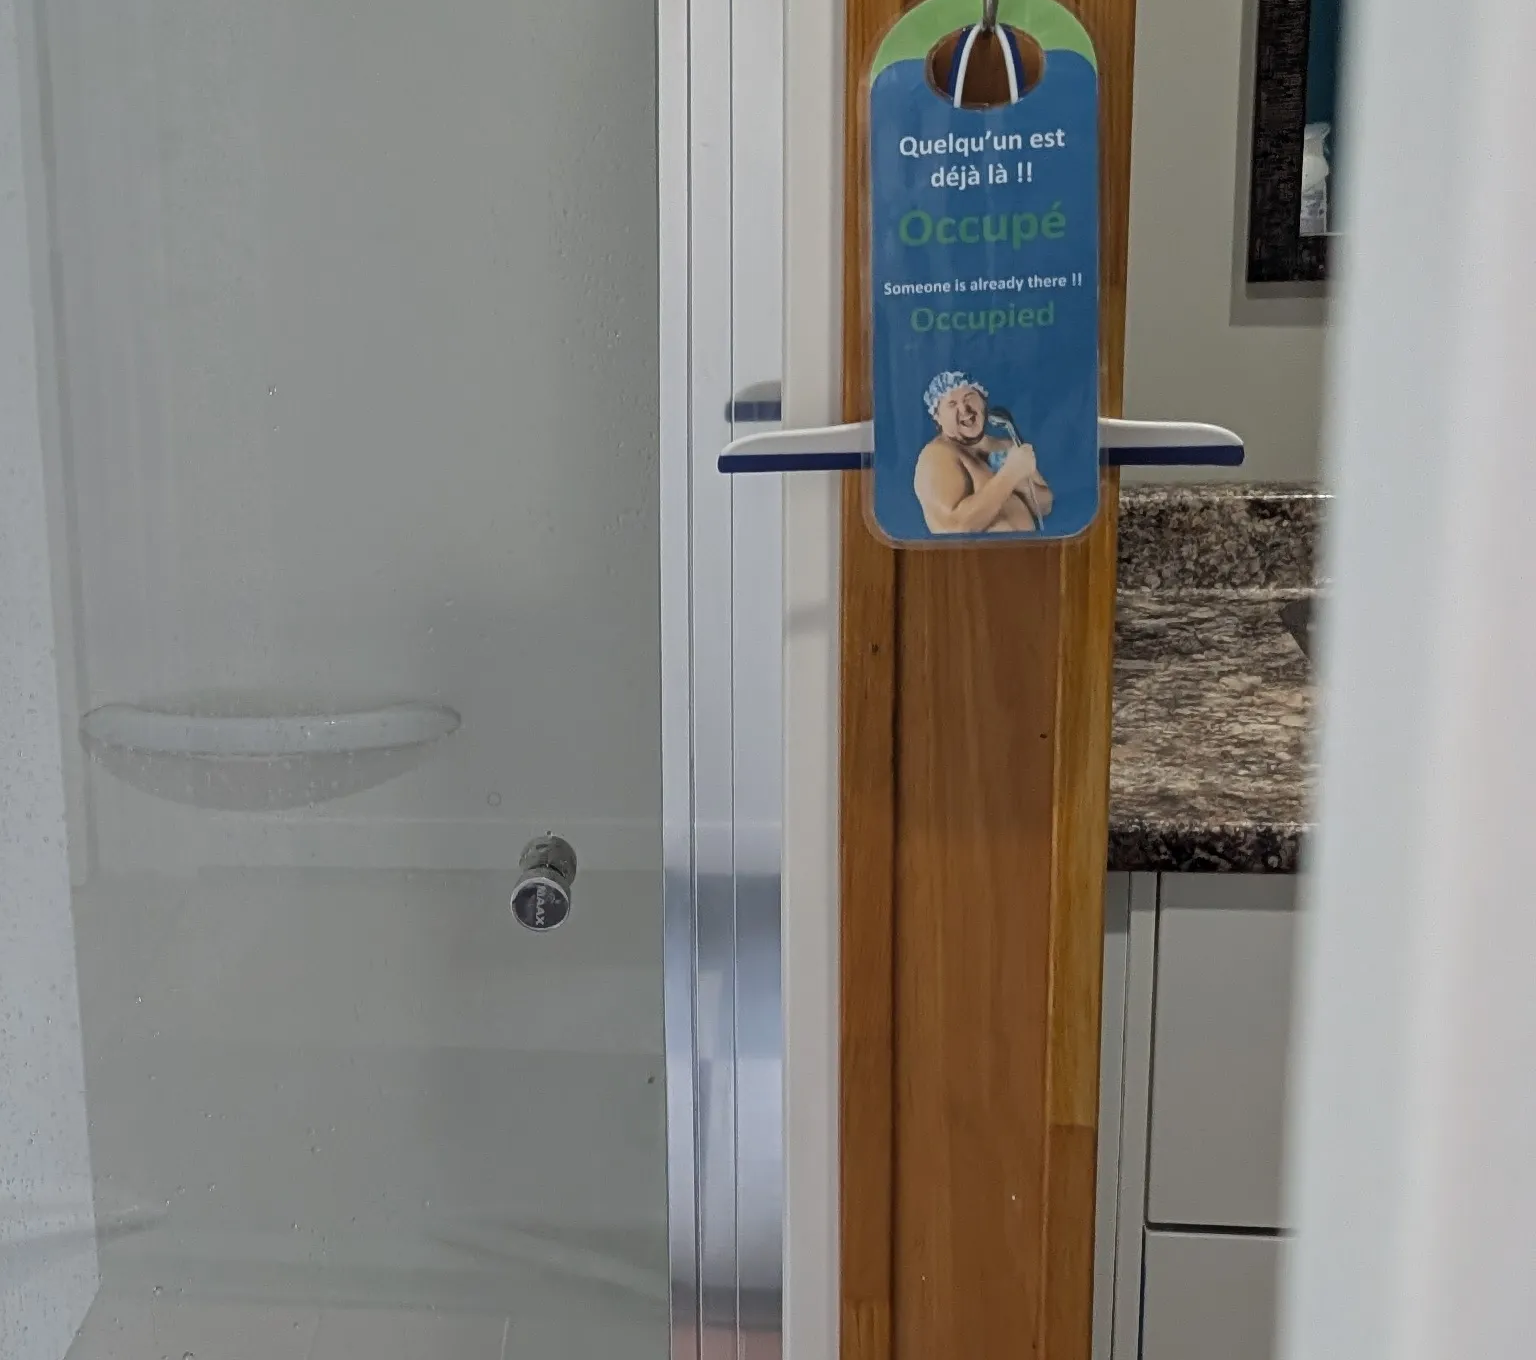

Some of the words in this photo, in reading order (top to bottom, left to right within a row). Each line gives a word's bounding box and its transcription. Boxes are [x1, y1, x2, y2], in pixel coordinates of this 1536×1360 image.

[1029, 128, 1066, 149] est
[930, 165, 980, 190] déjà
[988, 163, 1008, 185] là
[1016, 161, 1033, 183] !!
[898, 201, 1066, 250] Occupé
[883, 282, 951, 296] Someone
[954, 278, 965, 293] is
[970, 276, 1024, 292] already
[1027, 274, 1067, 289] there
[1071, 272, 1082, 287] !!
[910, 300, 1055, 335] Occupied
